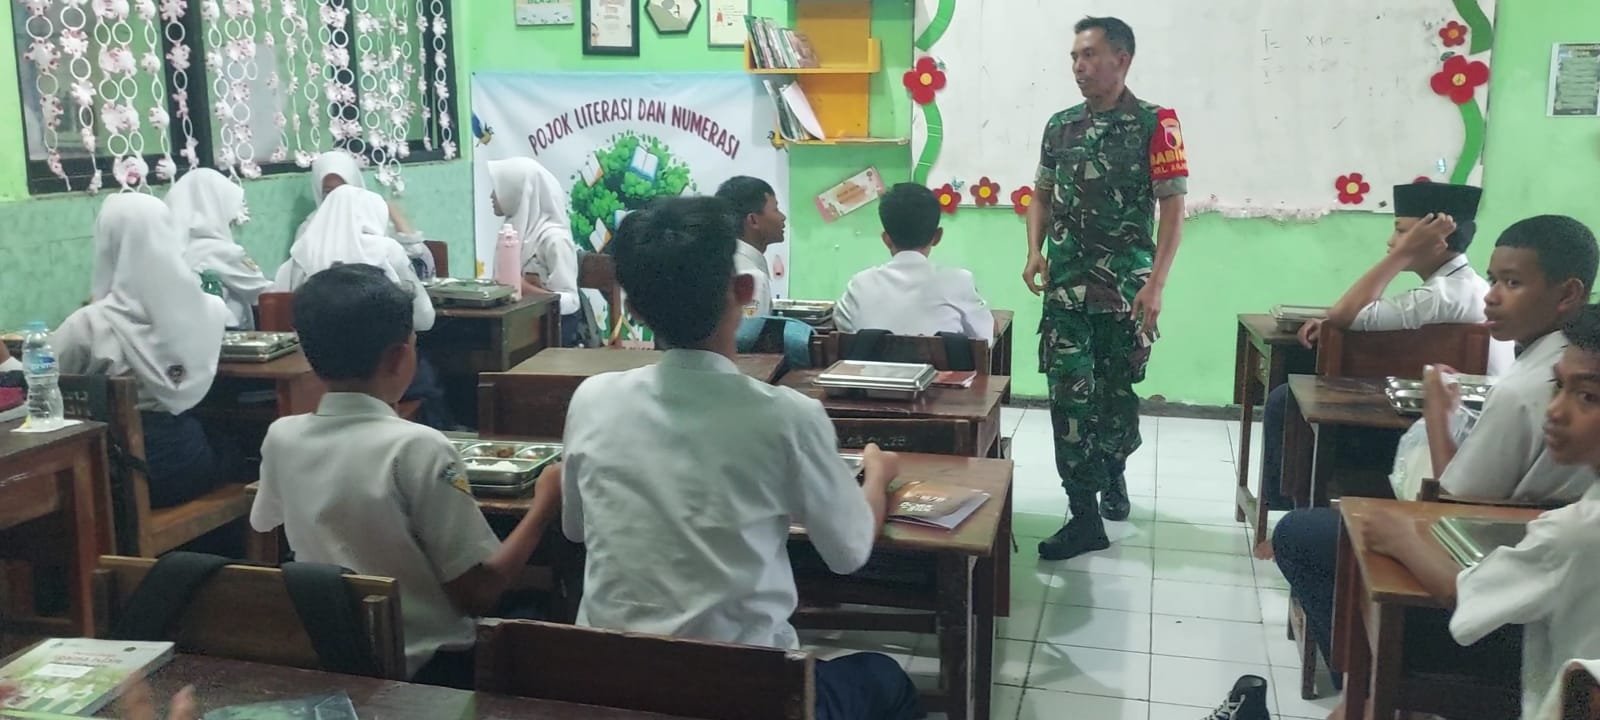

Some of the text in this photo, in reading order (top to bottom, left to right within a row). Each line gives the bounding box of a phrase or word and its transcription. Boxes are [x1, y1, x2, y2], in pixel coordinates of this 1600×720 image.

[528, 98, 740, 160] POJOK LITERASI DAN NUMERASI
